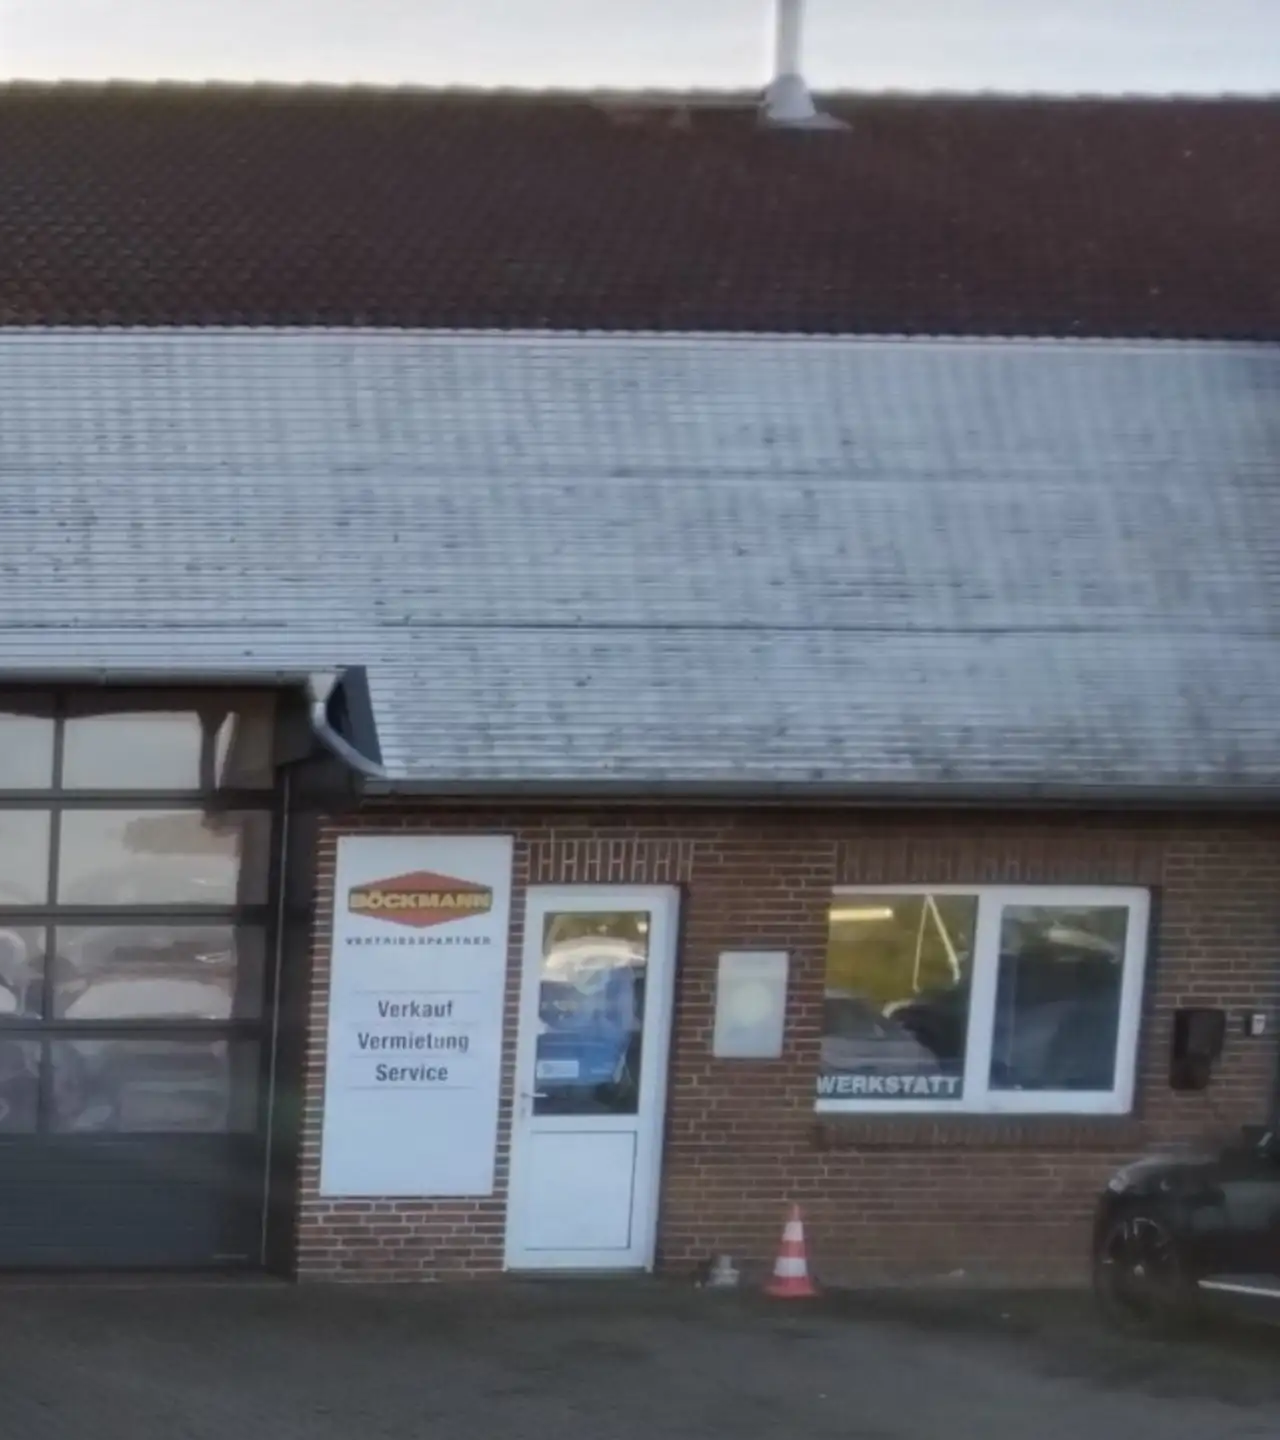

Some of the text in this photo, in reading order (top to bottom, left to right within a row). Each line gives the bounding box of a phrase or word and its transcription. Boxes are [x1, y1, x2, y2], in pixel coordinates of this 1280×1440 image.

[349, 889, 490, 910] BÖCKMANN
[377, 1000, 455, 1018] Verkauf
[357, 1031, 470, 1052] Vermietung
[375, 1063, 449, 1082] Service
[816, 1075, 960, 1095] WERKSTATT
